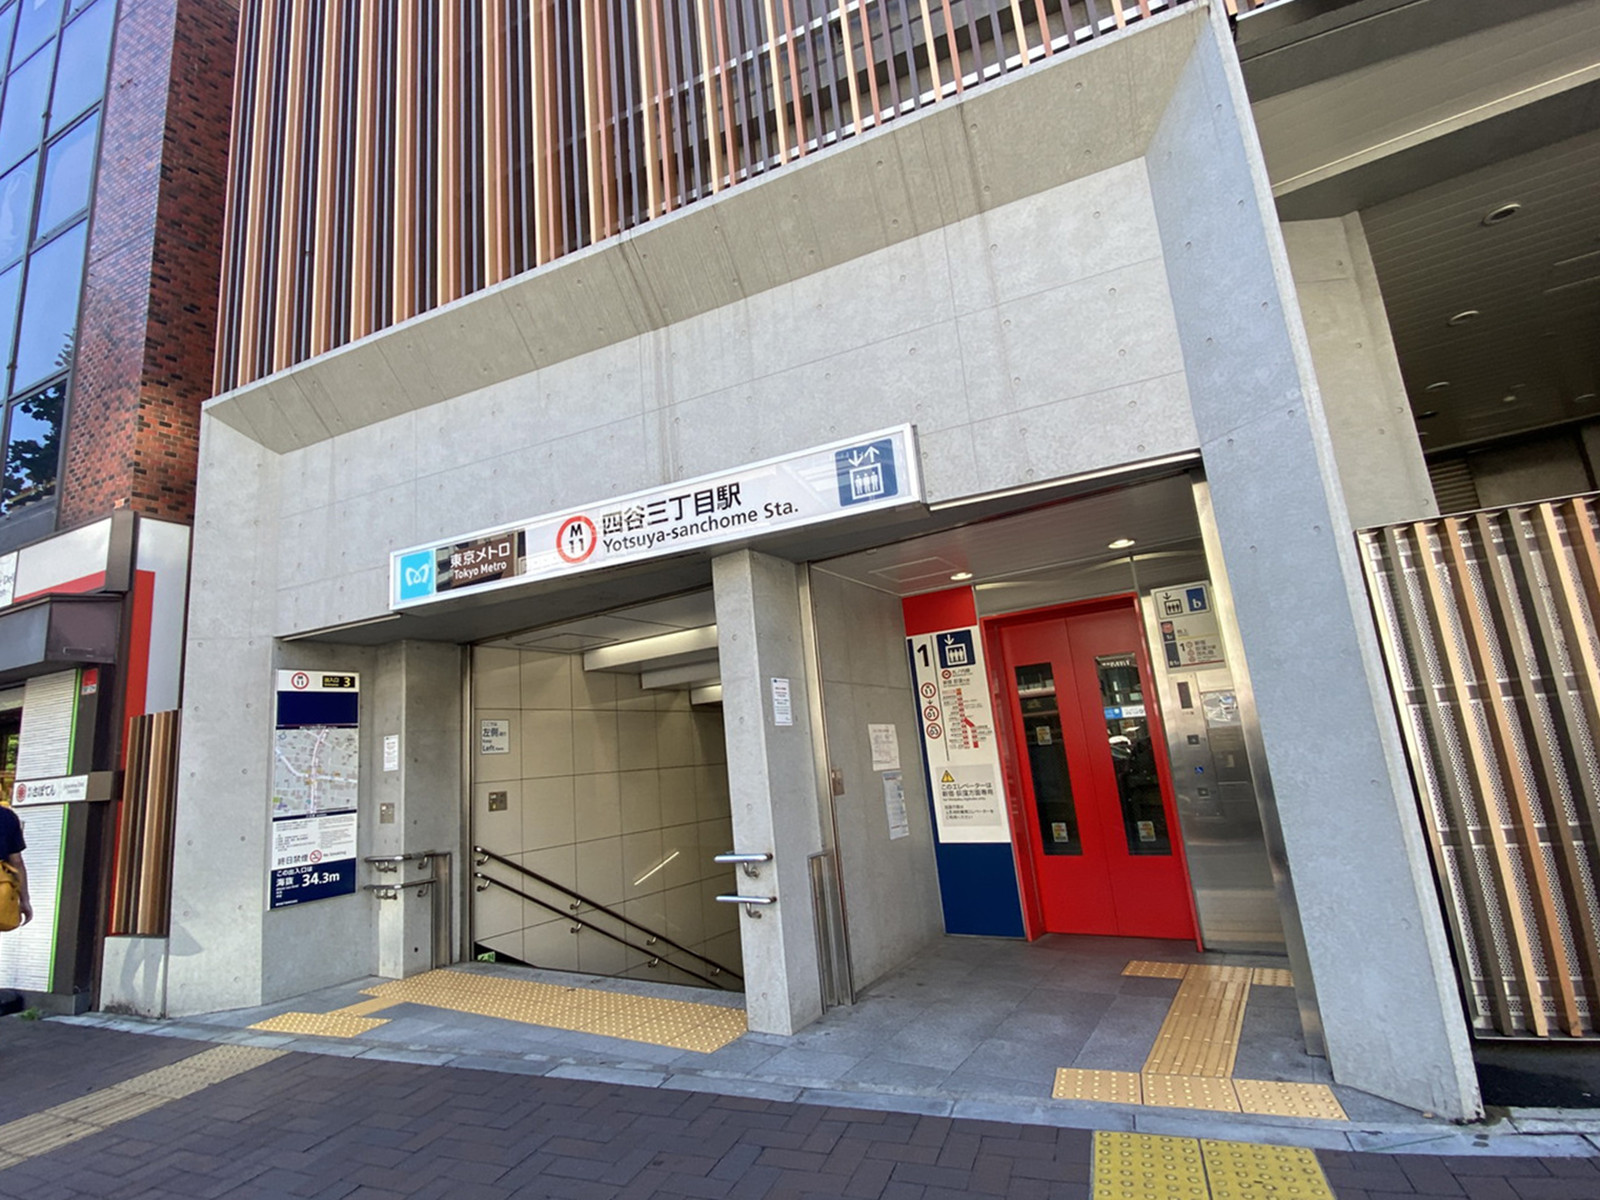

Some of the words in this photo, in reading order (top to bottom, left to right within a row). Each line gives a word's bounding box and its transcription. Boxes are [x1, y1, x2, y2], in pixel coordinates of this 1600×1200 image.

[602, 482, 741, 536] 四谷三丁目駅
[570, 524, 583, 538] M
[603, 510, 758, 553] Yotsuya-sanchome
[764, 500, 799, 519] Sta.
[569, 539, 585, 553] 11
[450, 542, 511, 569] 東京メトロ
[454, 566, 479, 580] Tokyo
[480, 561, 507, 575] Metro
[917, 644, 929, 667] 1
[1180, 643, 1185, 652] 1
[343, 677, 351, 687] 3
[301, 872, 340, 887] 34.3m
